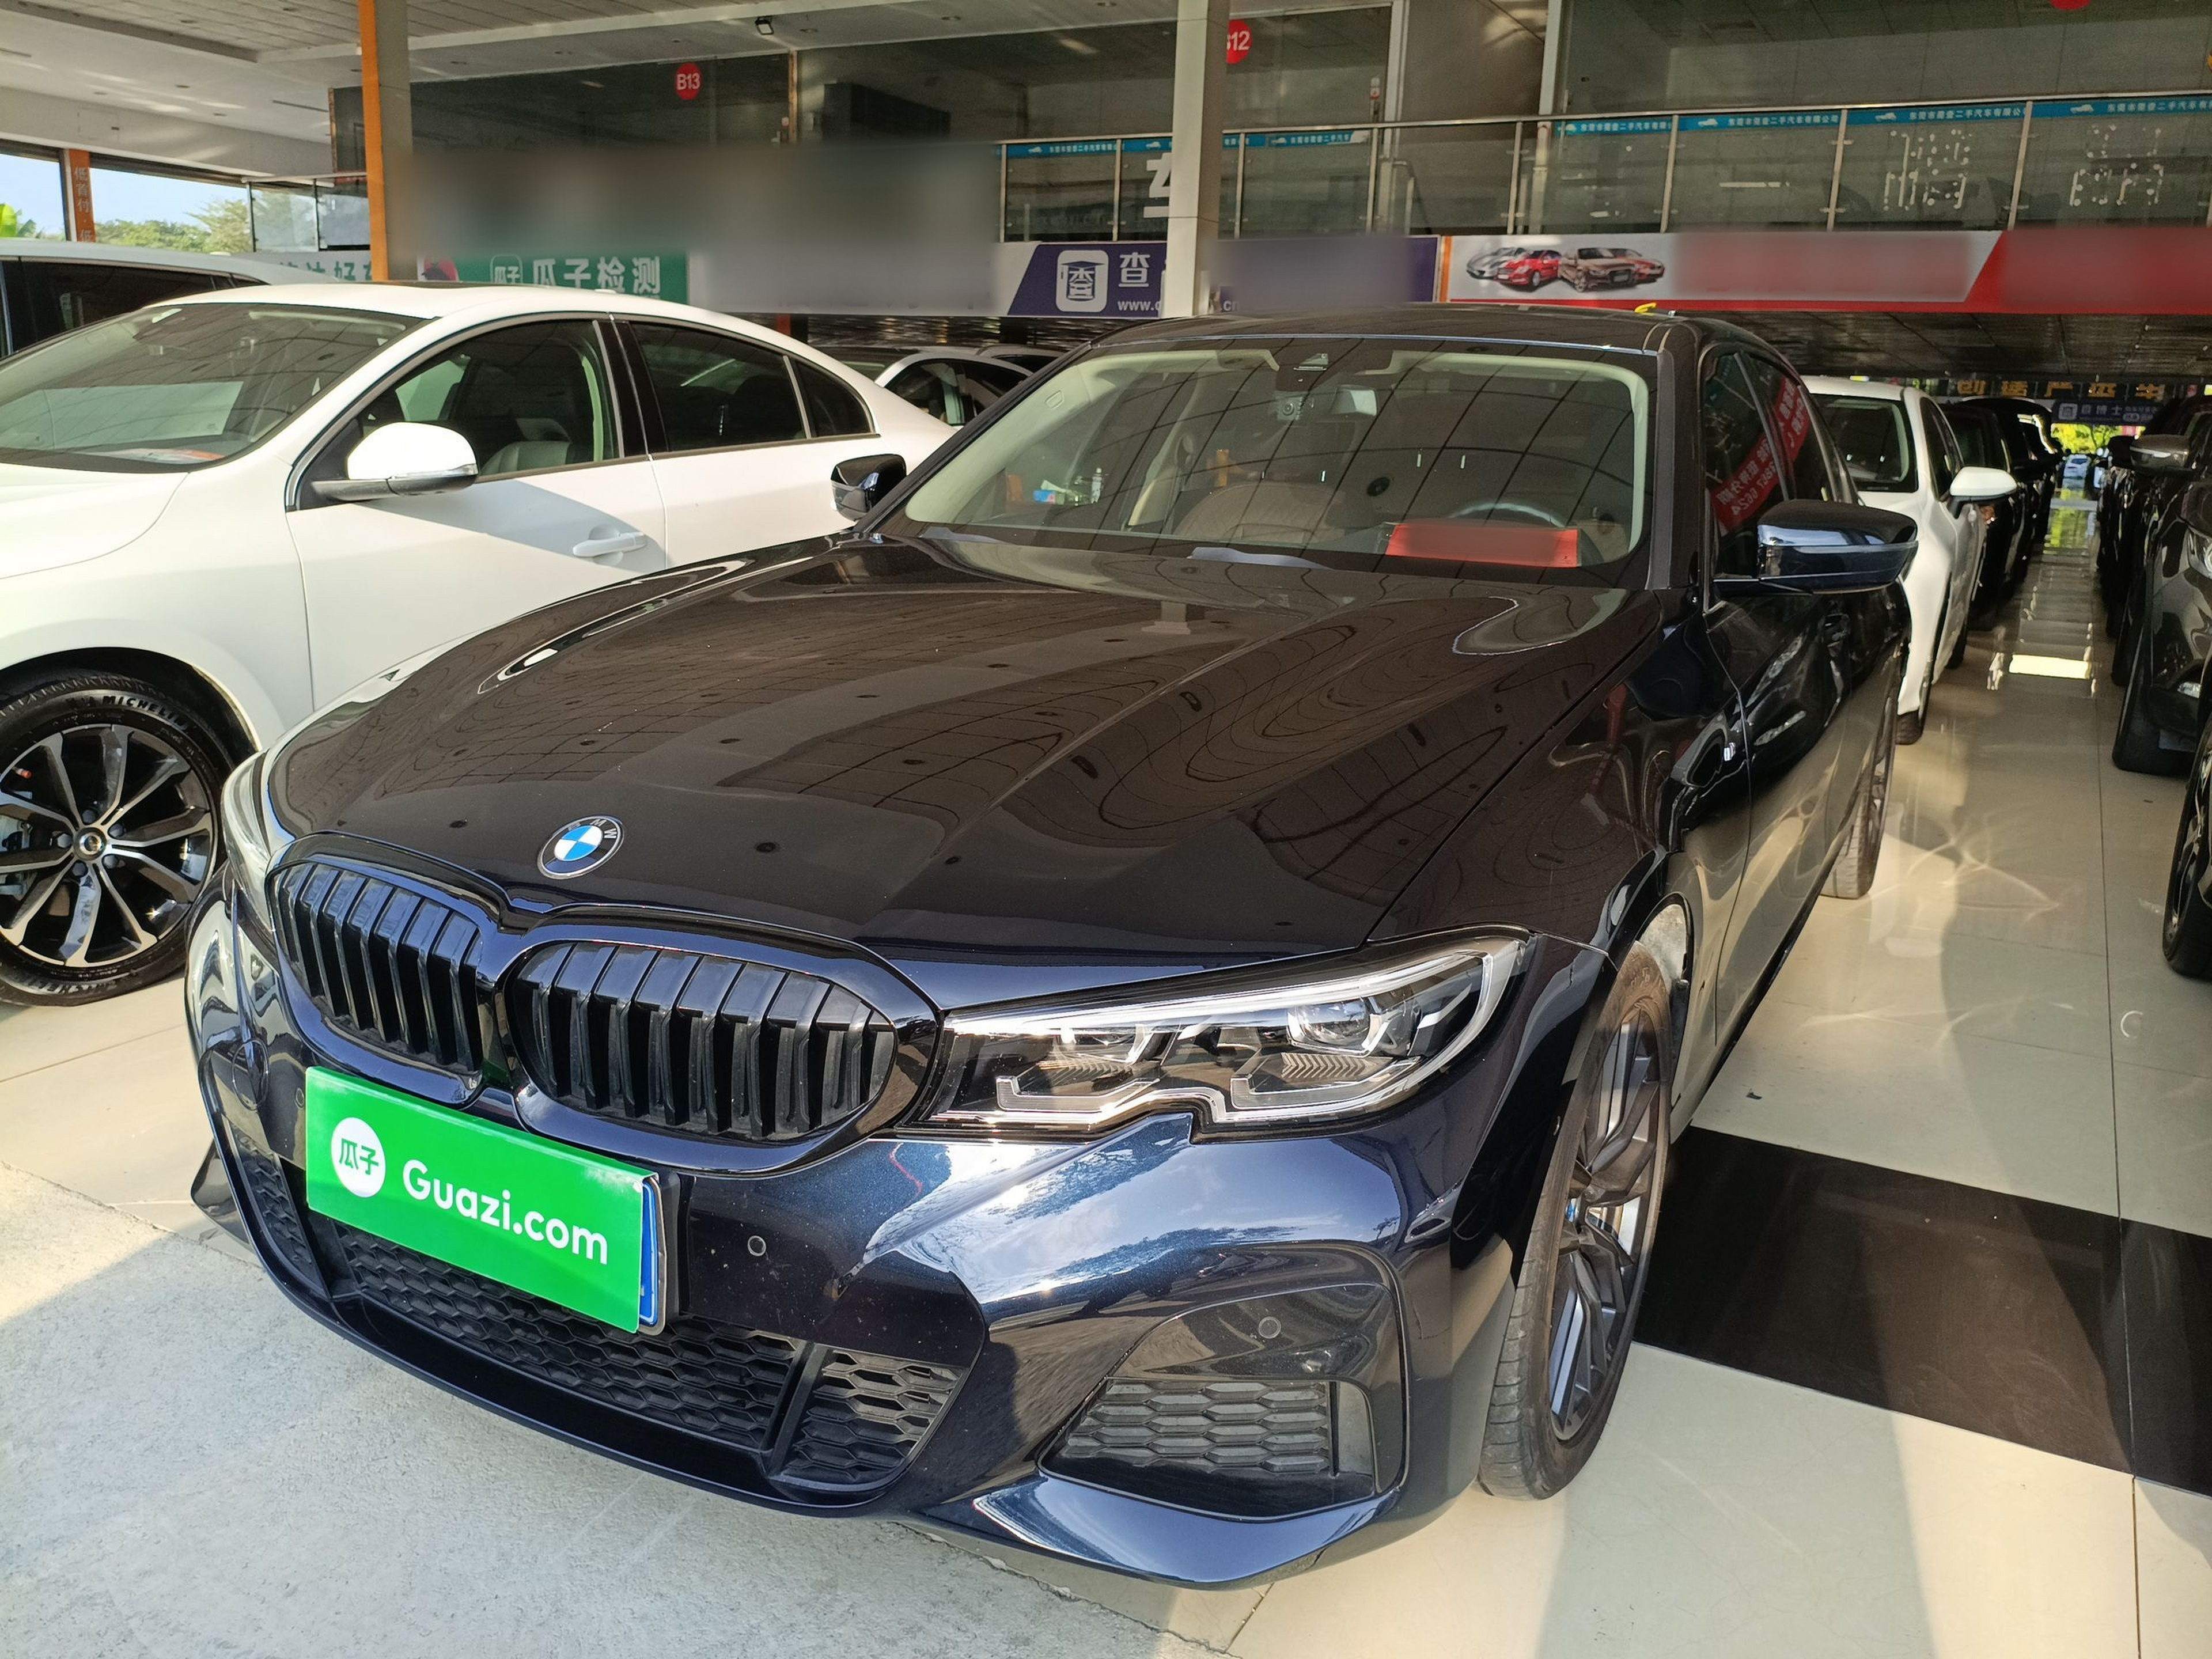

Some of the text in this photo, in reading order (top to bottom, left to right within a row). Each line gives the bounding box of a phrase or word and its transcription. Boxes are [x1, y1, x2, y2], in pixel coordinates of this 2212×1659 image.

[677, 73, 700, 90] B13
[532, 256, 661, 294] 瓜子检测
[1118, 252, 1151, 287] 查
[567, 818, 618, 839] BMW
[339, 1138, 380, 1176] 瓜子
[402, 1159, 608, 1266] Guazi.com
